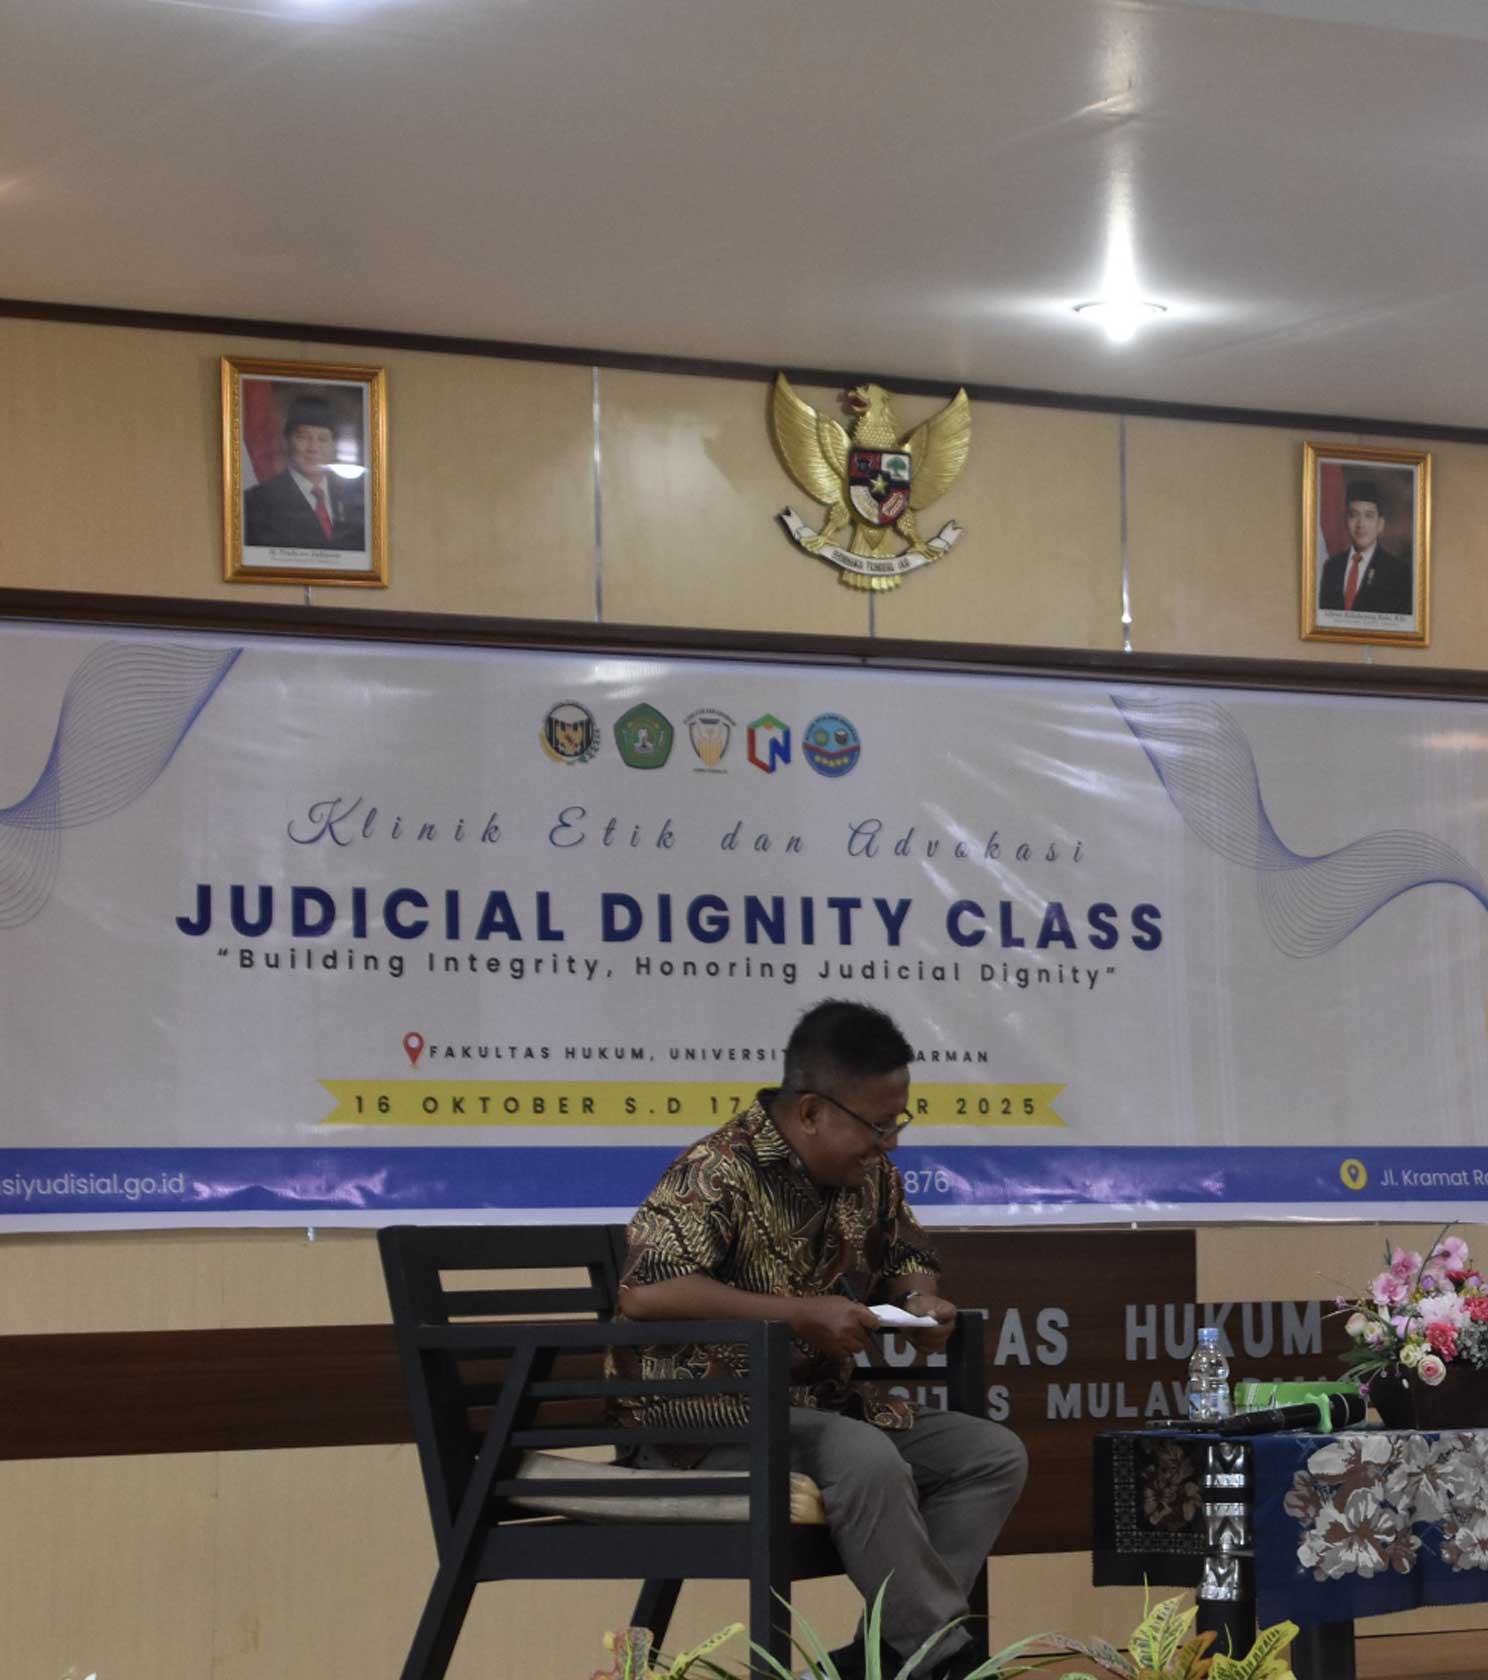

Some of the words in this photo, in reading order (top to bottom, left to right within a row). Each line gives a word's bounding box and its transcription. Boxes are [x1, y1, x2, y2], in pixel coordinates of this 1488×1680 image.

[287, 796, 501, 847] Klinik
[549, 805, 675, 849] Etik
[721, 819, 803, 852] dan
[848, 818, 1084, 864] Advokasi
[175, 883, 564, 941] JUDICIAL
[600, 892, 912, 946] DIGNITY
[946, 900, 1163, 951] CLASS
[428, 953, 613, 980] Integrity,
[635, 957, 797, 984] Honoring
[818, 960, 960, 982] Judicial
[430, 1046, 550, 1059] FAKULTAS
[565, 1048, 654, 1062] HUKUM,
[670, 1048, 784, 1062] UNIVERSI
[913, 1050, 989, 1064] ARMAN
[355, 1096, 390, 1113] 16
[422, 1097, 595, 1114] OKTOBER
[710, 1097, 742, 1115] 17
[956, 1097, 1035, 1116] 2025
[904, 1170, 950, 1194] 876
[1380, 1170, 1398, 1187] Jl.
[1402, 1169, 1469, 1187] Kramat
[1125, 1303, 1322, 1360] HUKUM
